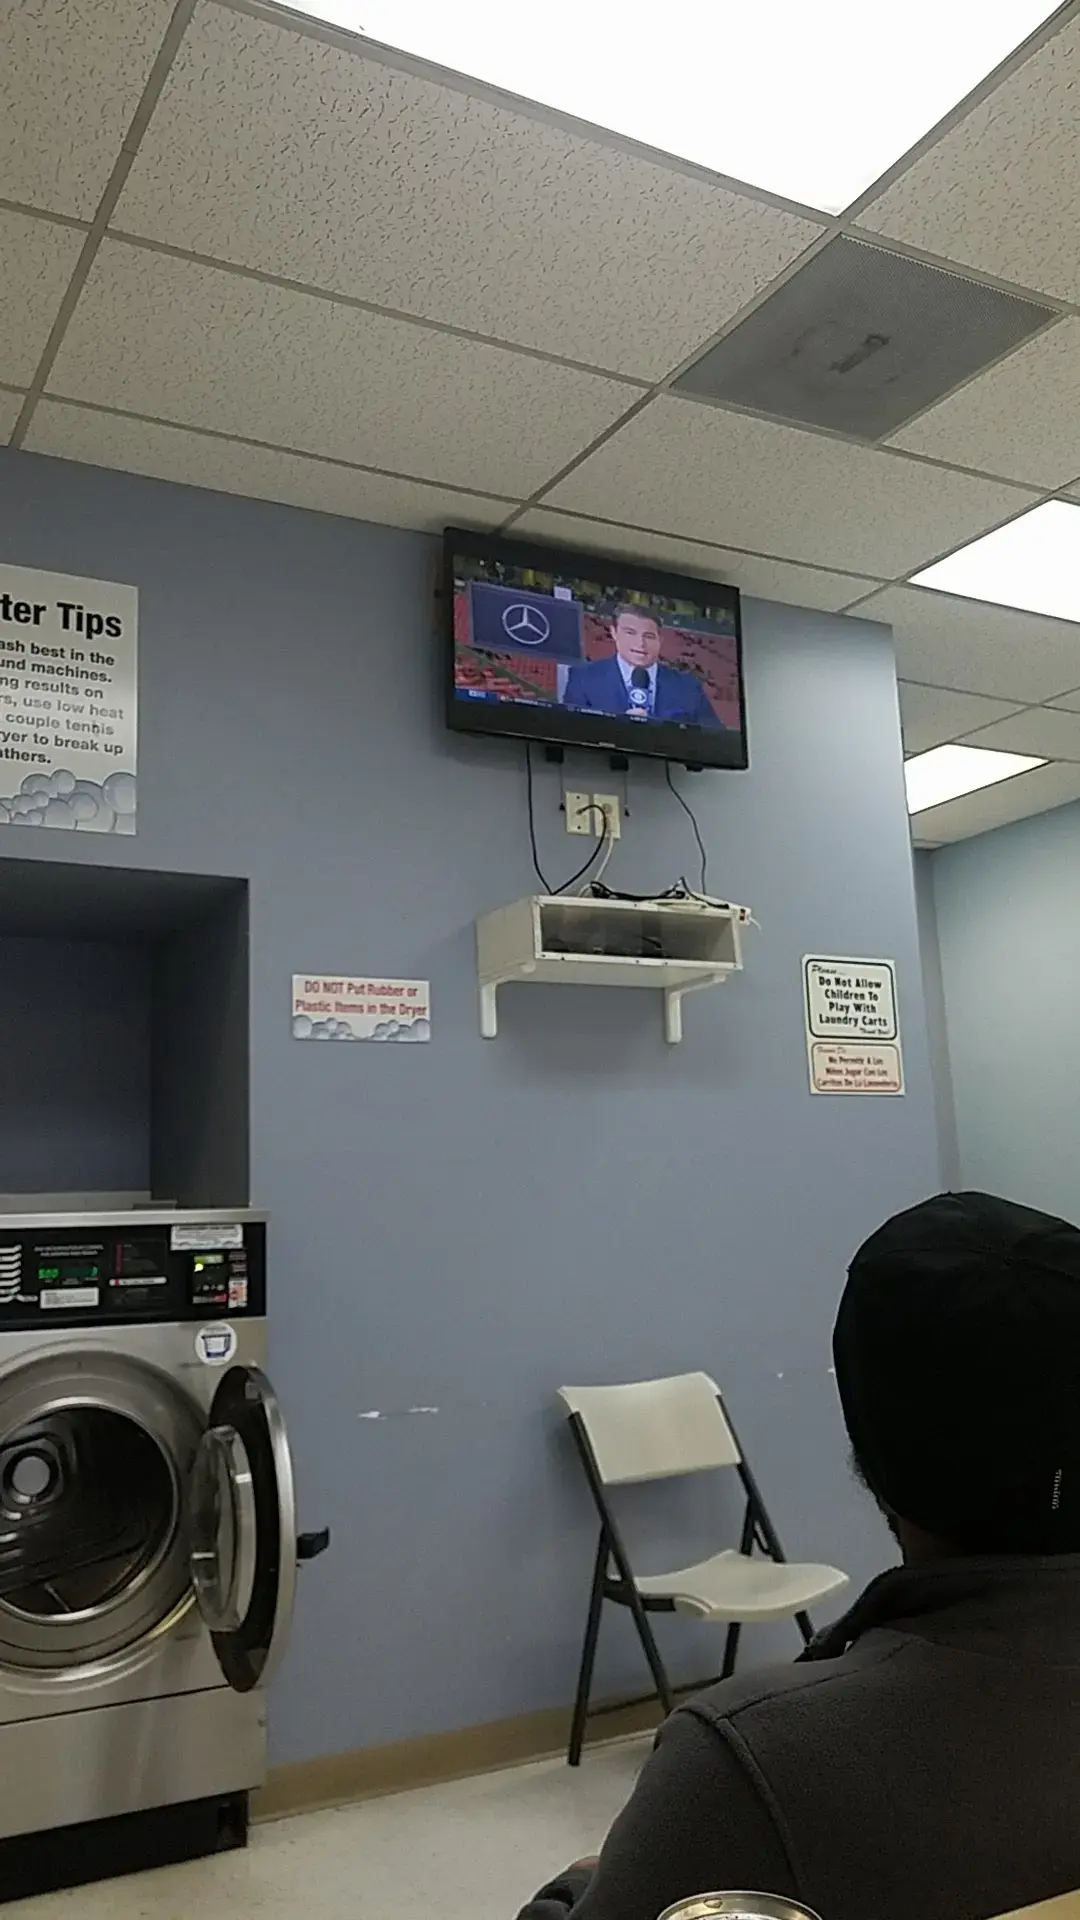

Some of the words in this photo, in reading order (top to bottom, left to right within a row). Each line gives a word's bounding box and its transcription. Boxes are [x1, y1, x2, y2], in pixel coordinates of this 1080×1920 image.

[56, 602, 122, 640] Tips
[30, 643, 65, 659] best
[70, 648, 85, 661] in
[90, 652, 115, 667] the
[31, 662, 112, 683] machines.
[24, 679, 80, 696] results
[84, 688, 104, 700] on
[23, 697, 52, 710] use
[57, 700, 85, 714] low
[89, 704, 124, 720] heat
[6, 713, 60, 730] couple
[33, 732, 49, 746] to
[54, 734, 100, 752] break
[103, 743, 124, 756] up
[304, 980, 320, 994] DO
[323, 981, 344, 995] NOT
[818, 976, 832, 986] Do
[834, 977, 852, 988] Not
[855, 978, 883, 988] Allow
[824, 989, 866, 1000] Children
[868, 991, 879, 1001] To
[829, 1001, 850, 1015] Play
[853, 1003, 877, 1013] With
[818, 1013, 859, 1027] Laundry
[862, 1015, 888, 1027] Carts
